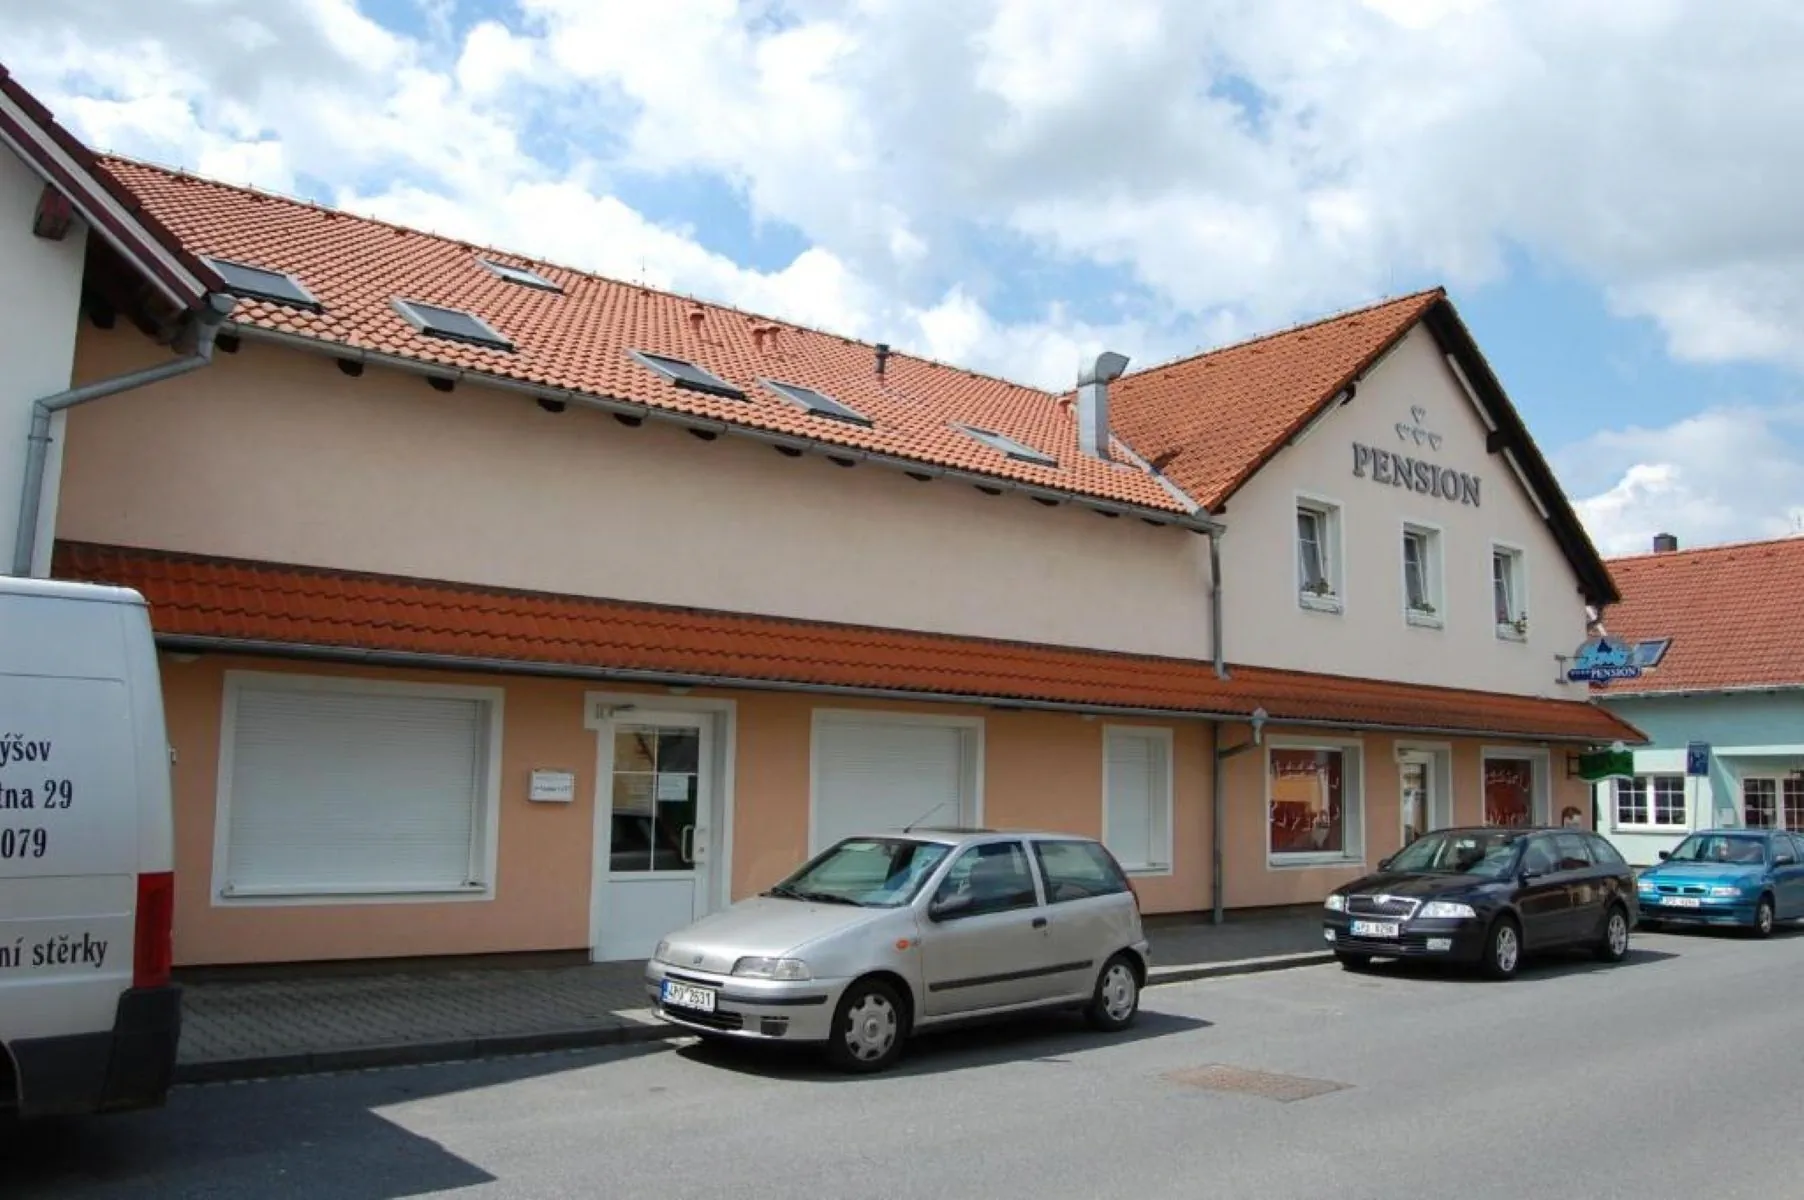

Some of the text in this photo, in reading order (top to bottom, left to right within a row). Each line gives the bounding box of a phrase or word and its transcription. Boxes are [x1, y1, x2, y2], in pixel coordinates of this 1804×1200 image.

[1352, 441, 1481, 508] PENSION
[1591, 666, 1635, 677] PENSION
[43, 779, 73, 809] 29
[0, 828, 48, 859] 079
[32, 932, 108, 968] stěrky
